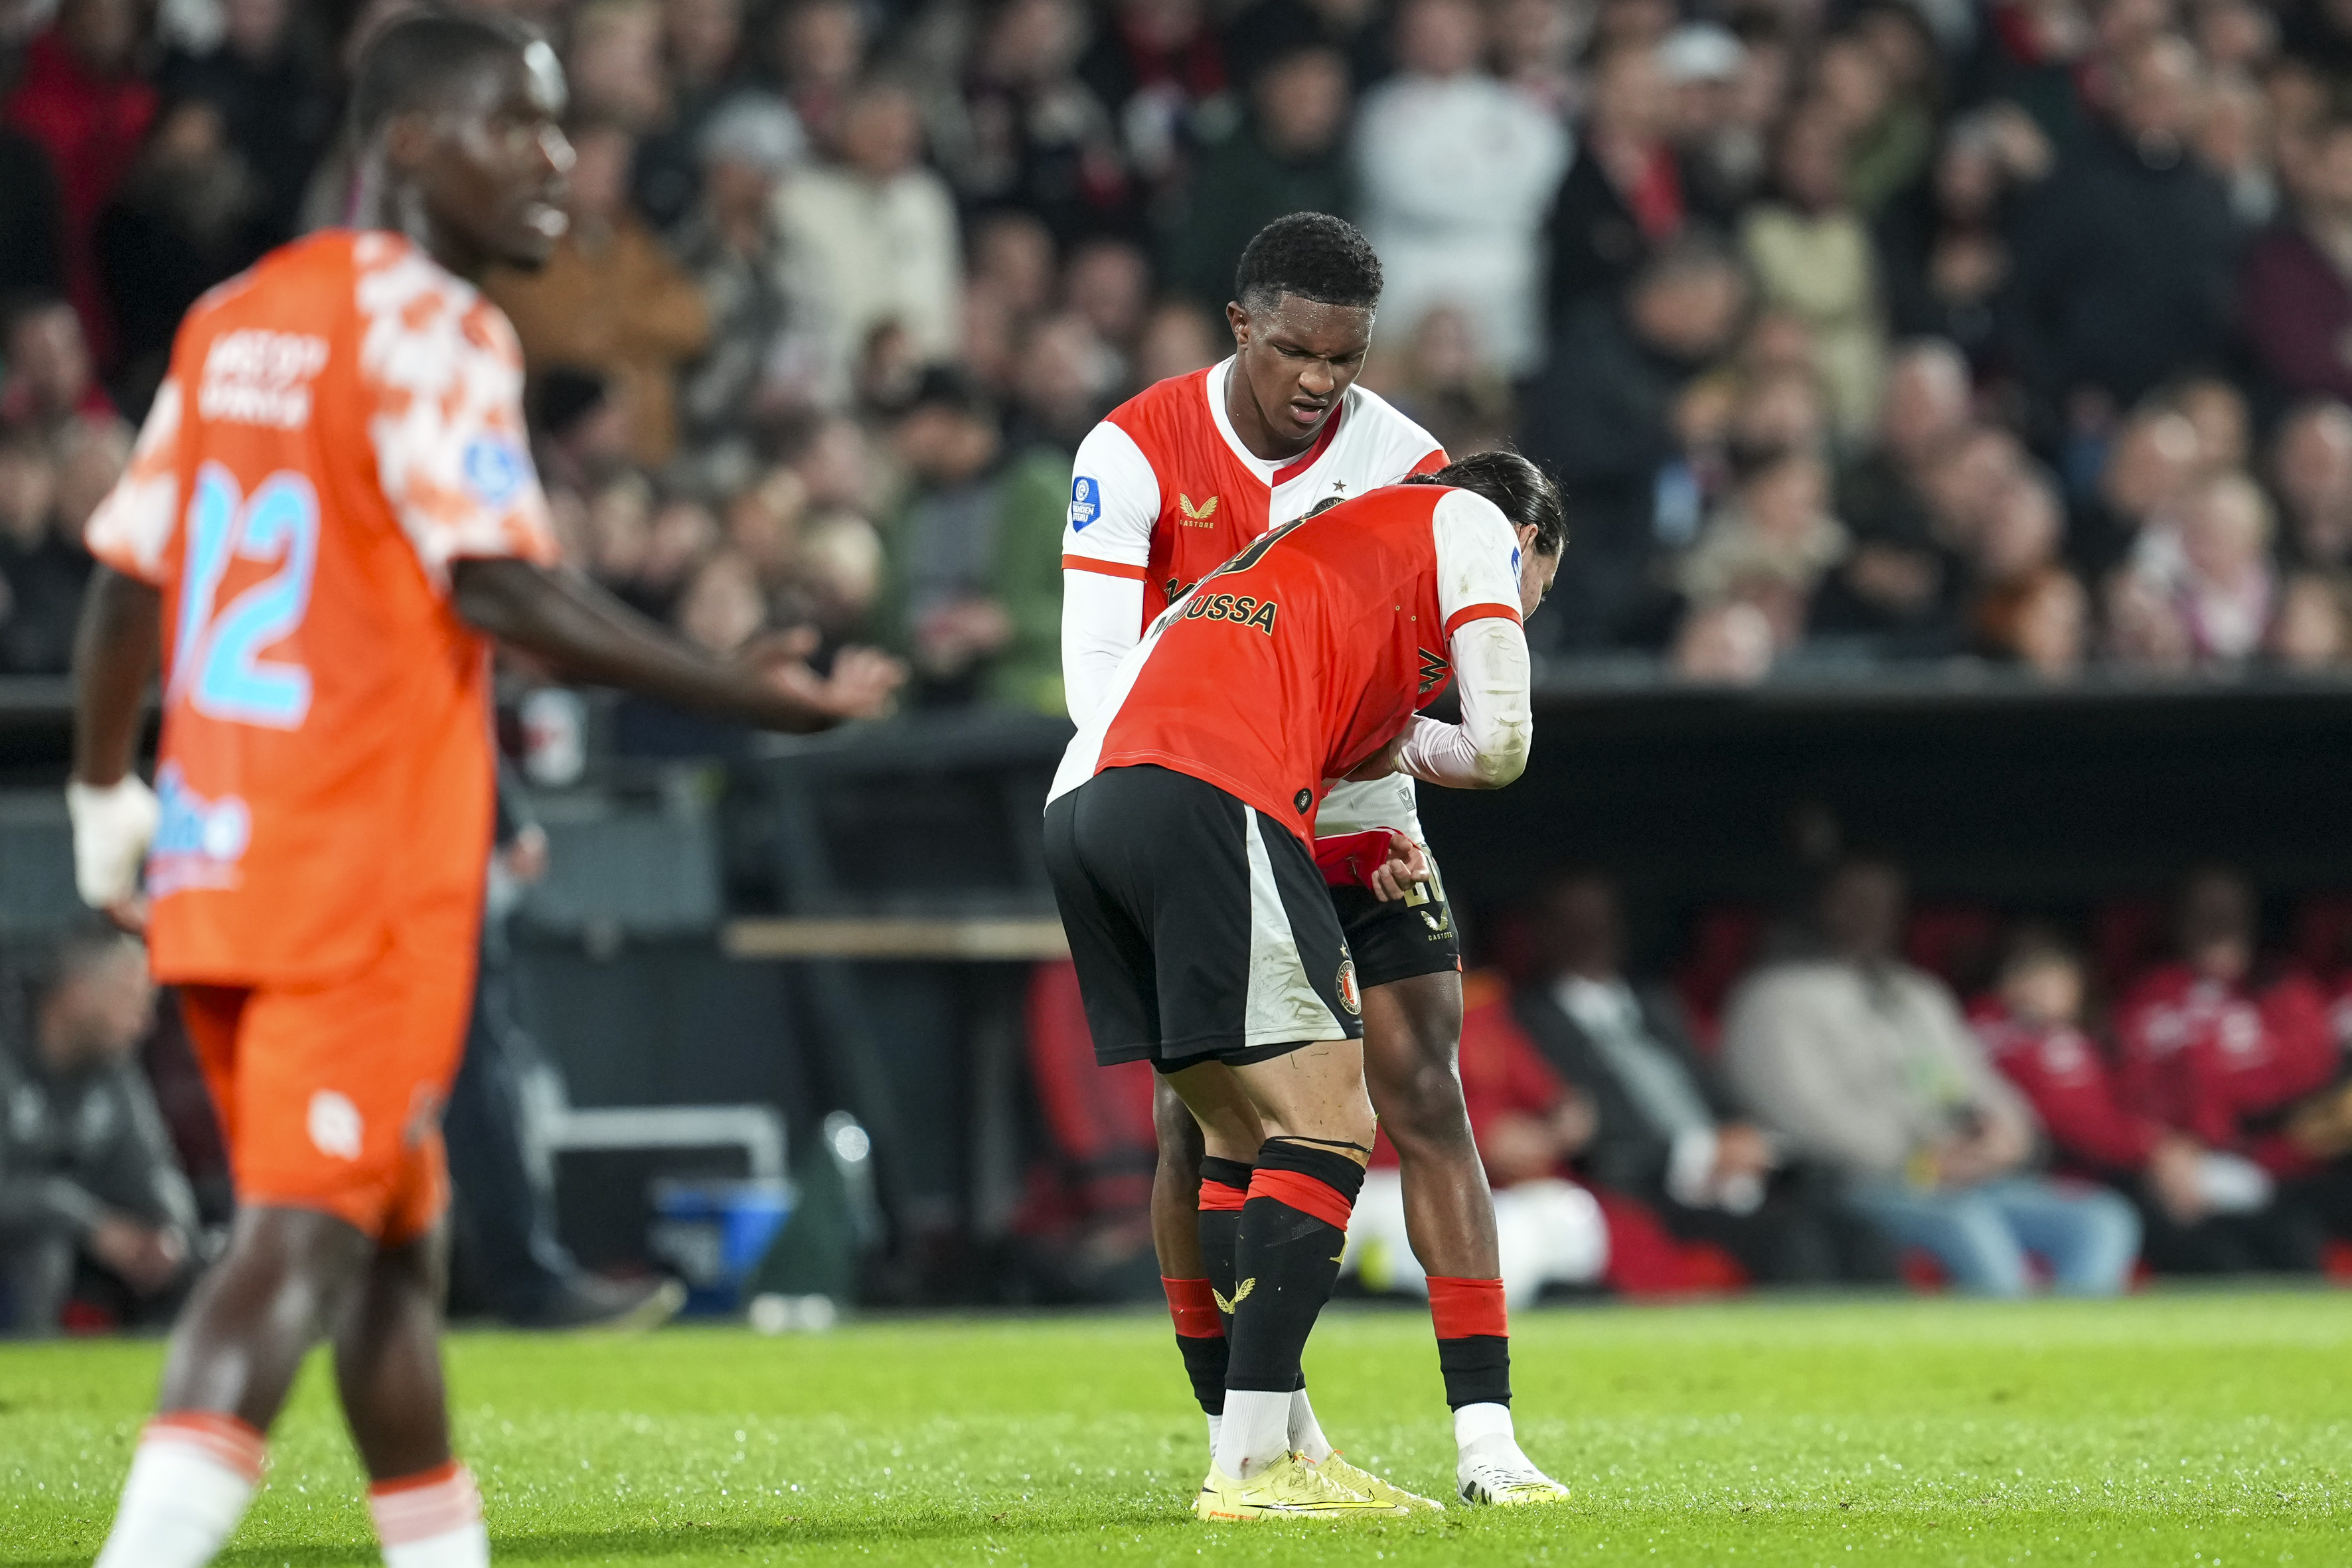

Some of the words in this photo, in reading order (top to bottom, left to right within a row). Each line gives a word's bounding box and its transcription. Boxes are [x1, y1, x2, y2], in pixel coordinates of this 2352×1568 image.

[1179, 519, 1214, 529] CASTORE
[170, 459, 321, 730] 12
[1428, 931, 1452, 941] CASTORE
